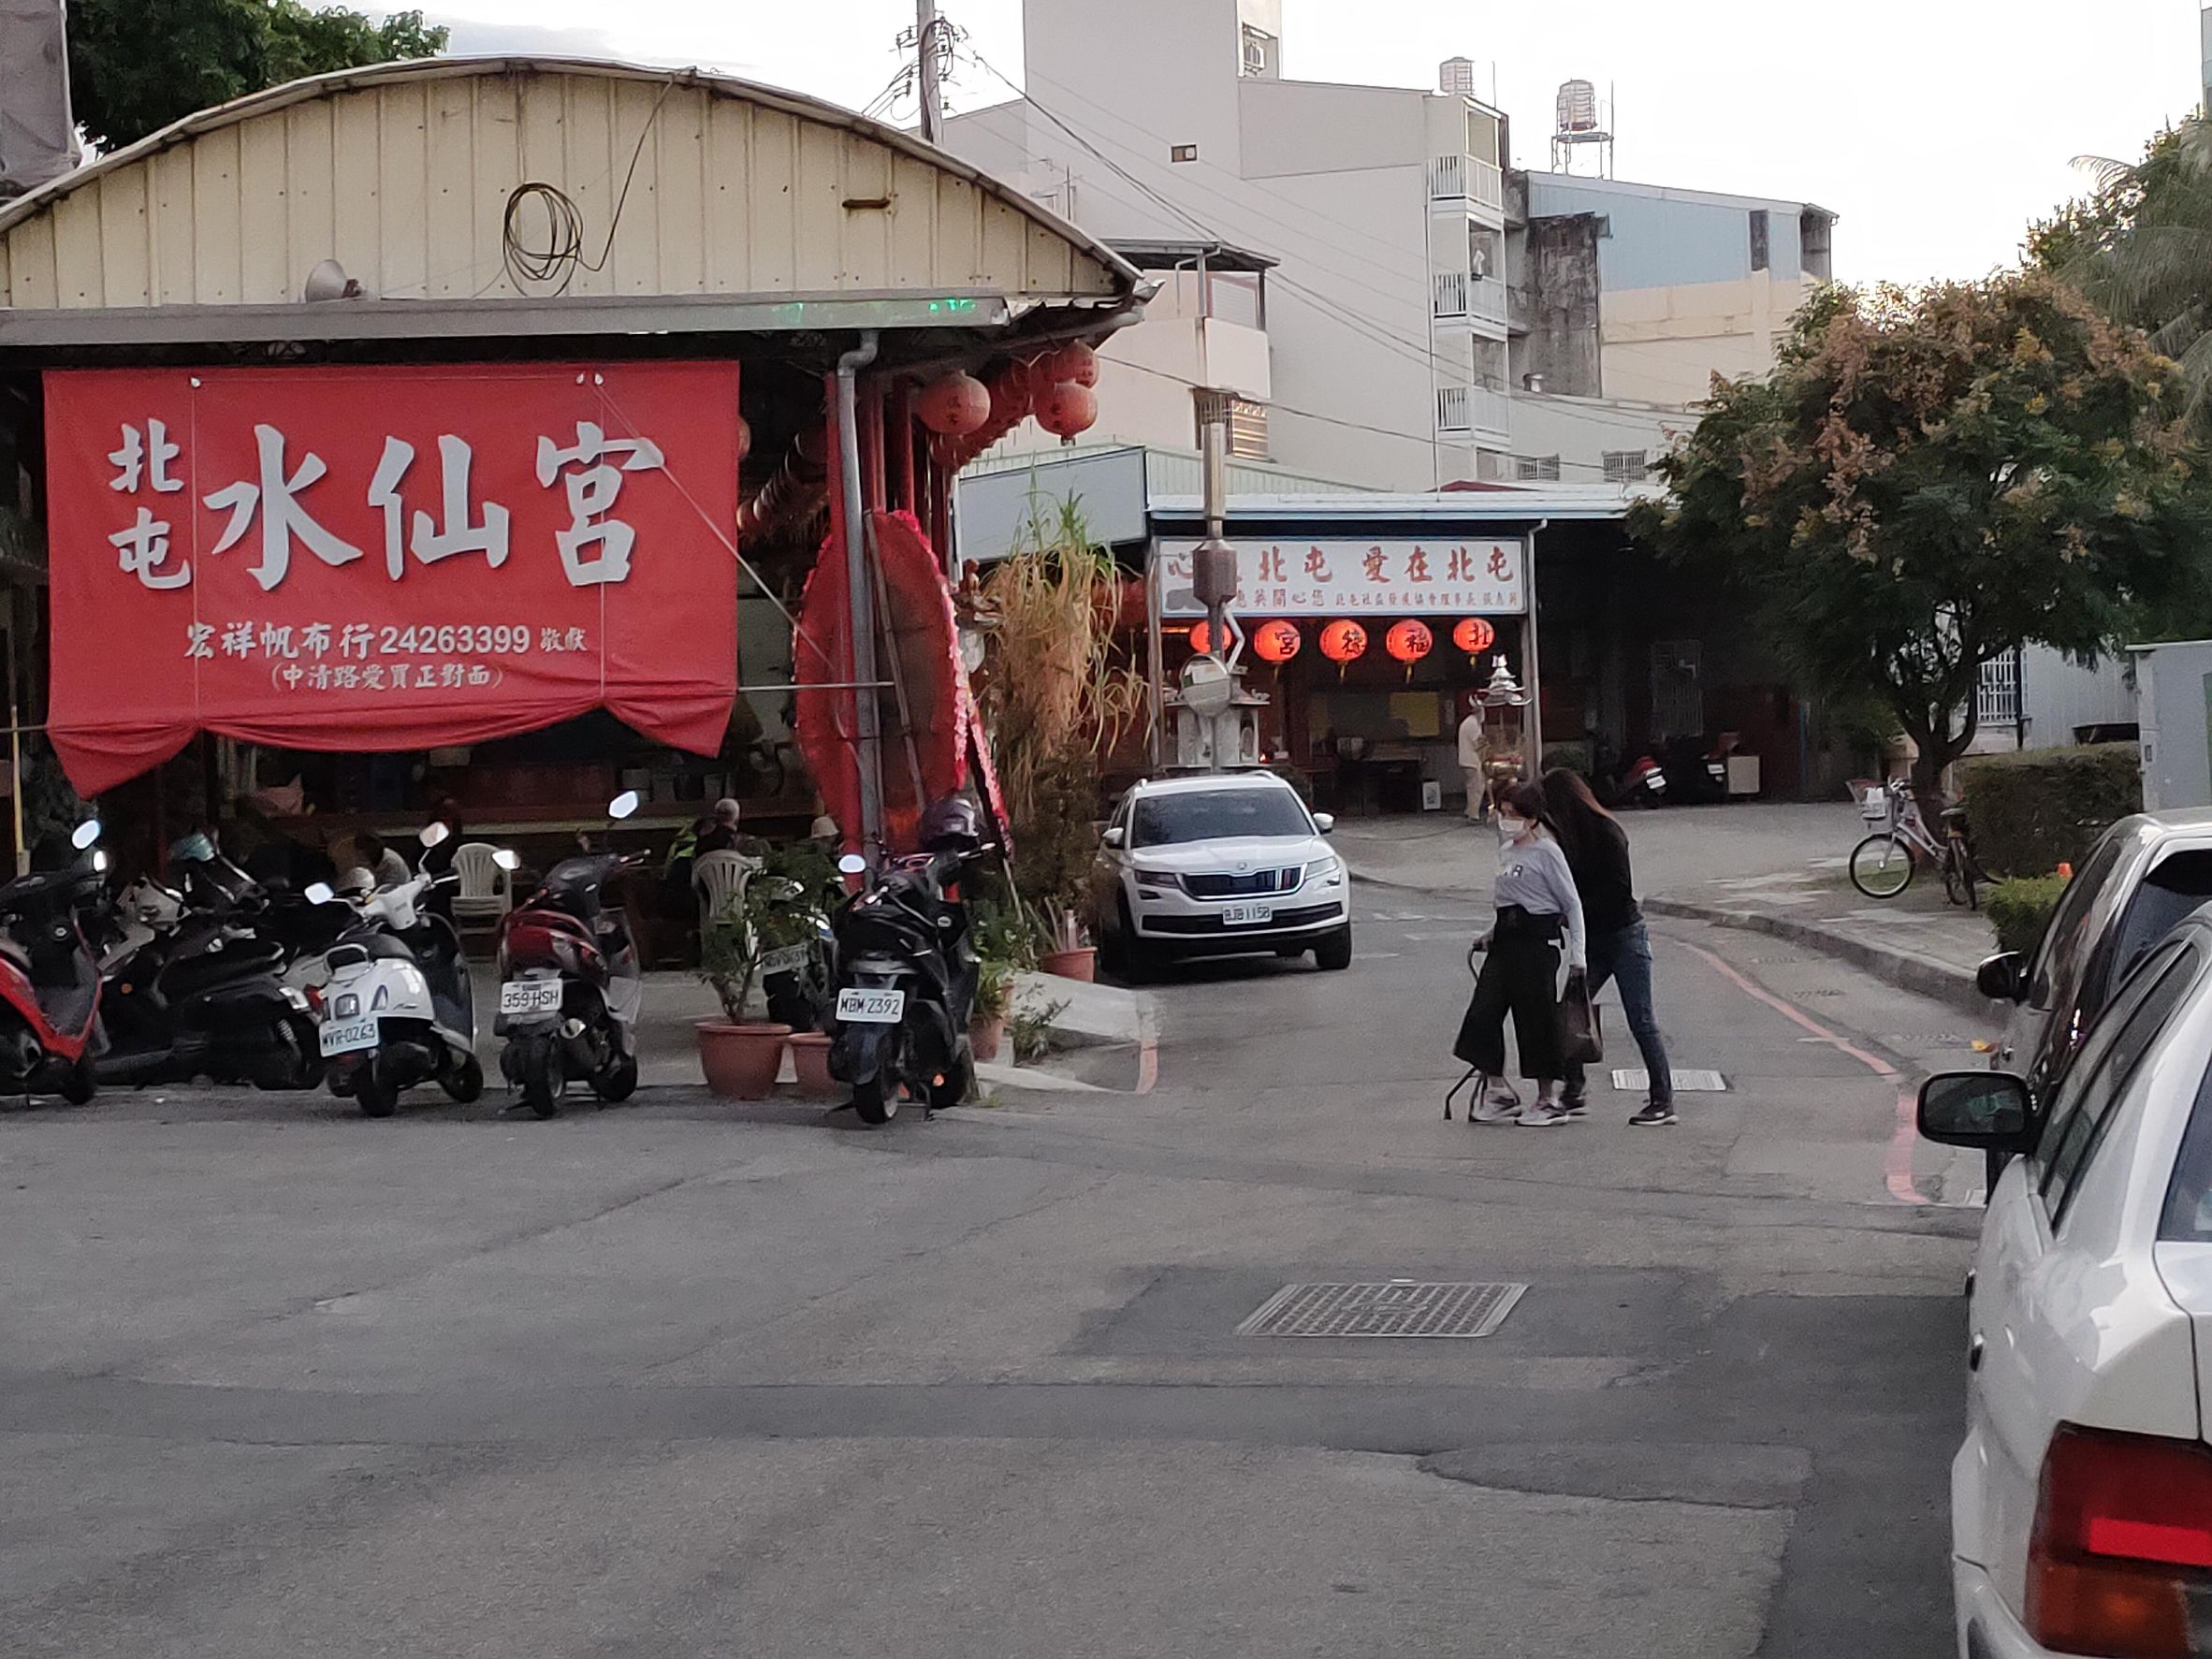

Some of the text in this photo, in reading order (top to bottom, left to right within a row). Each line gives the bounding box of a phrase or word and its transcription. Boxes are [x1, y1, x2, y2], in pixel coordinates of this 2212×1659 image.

[108, 417, 191, 590] 北屯
[202, 422, 665, 591] 水仙宮
[1362, 545, 1514, 583] 愛在北屯
